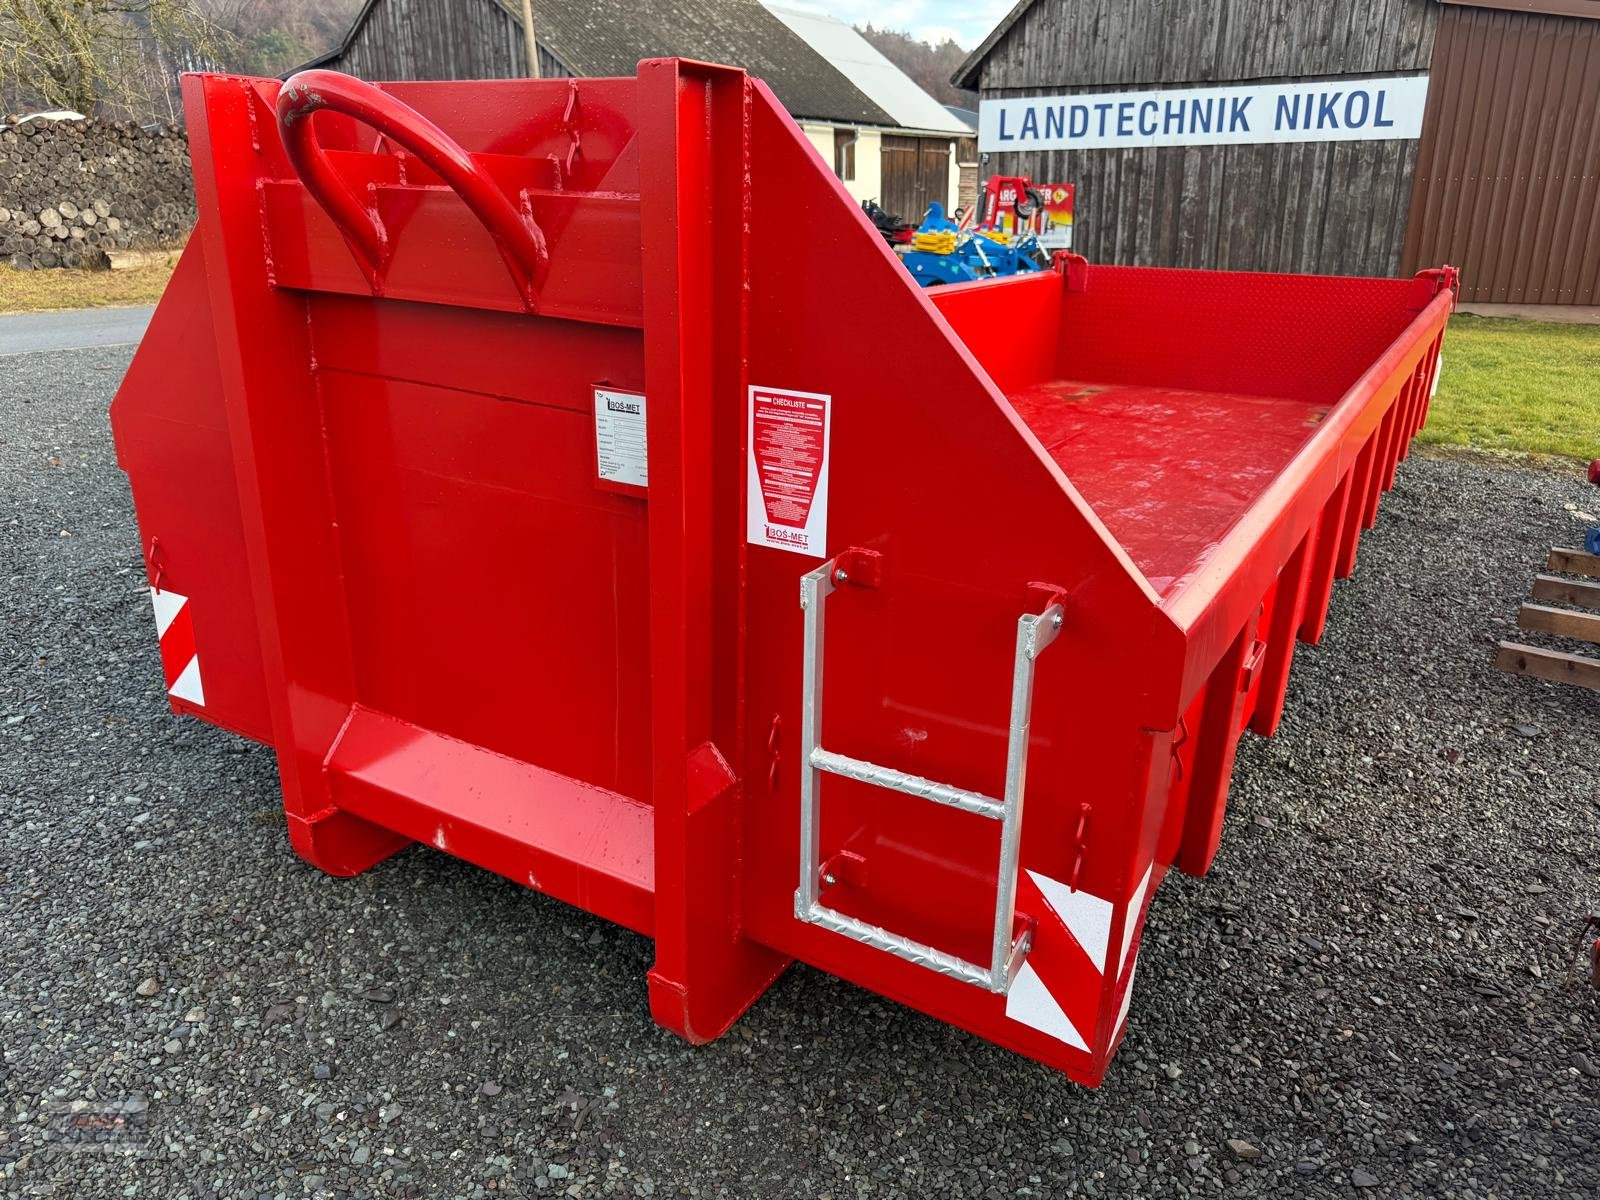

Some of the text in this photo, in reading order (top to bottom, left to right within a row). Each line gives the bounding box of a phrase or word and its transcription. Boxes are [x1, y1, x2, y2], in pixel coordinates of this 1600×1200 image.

[999, 90, 1394, 141] LANDTECHNIK NIKOL
[772, 397, 806, 409] CHECKLISTE
[769, 527, 809, 543] BOŚ-MET
